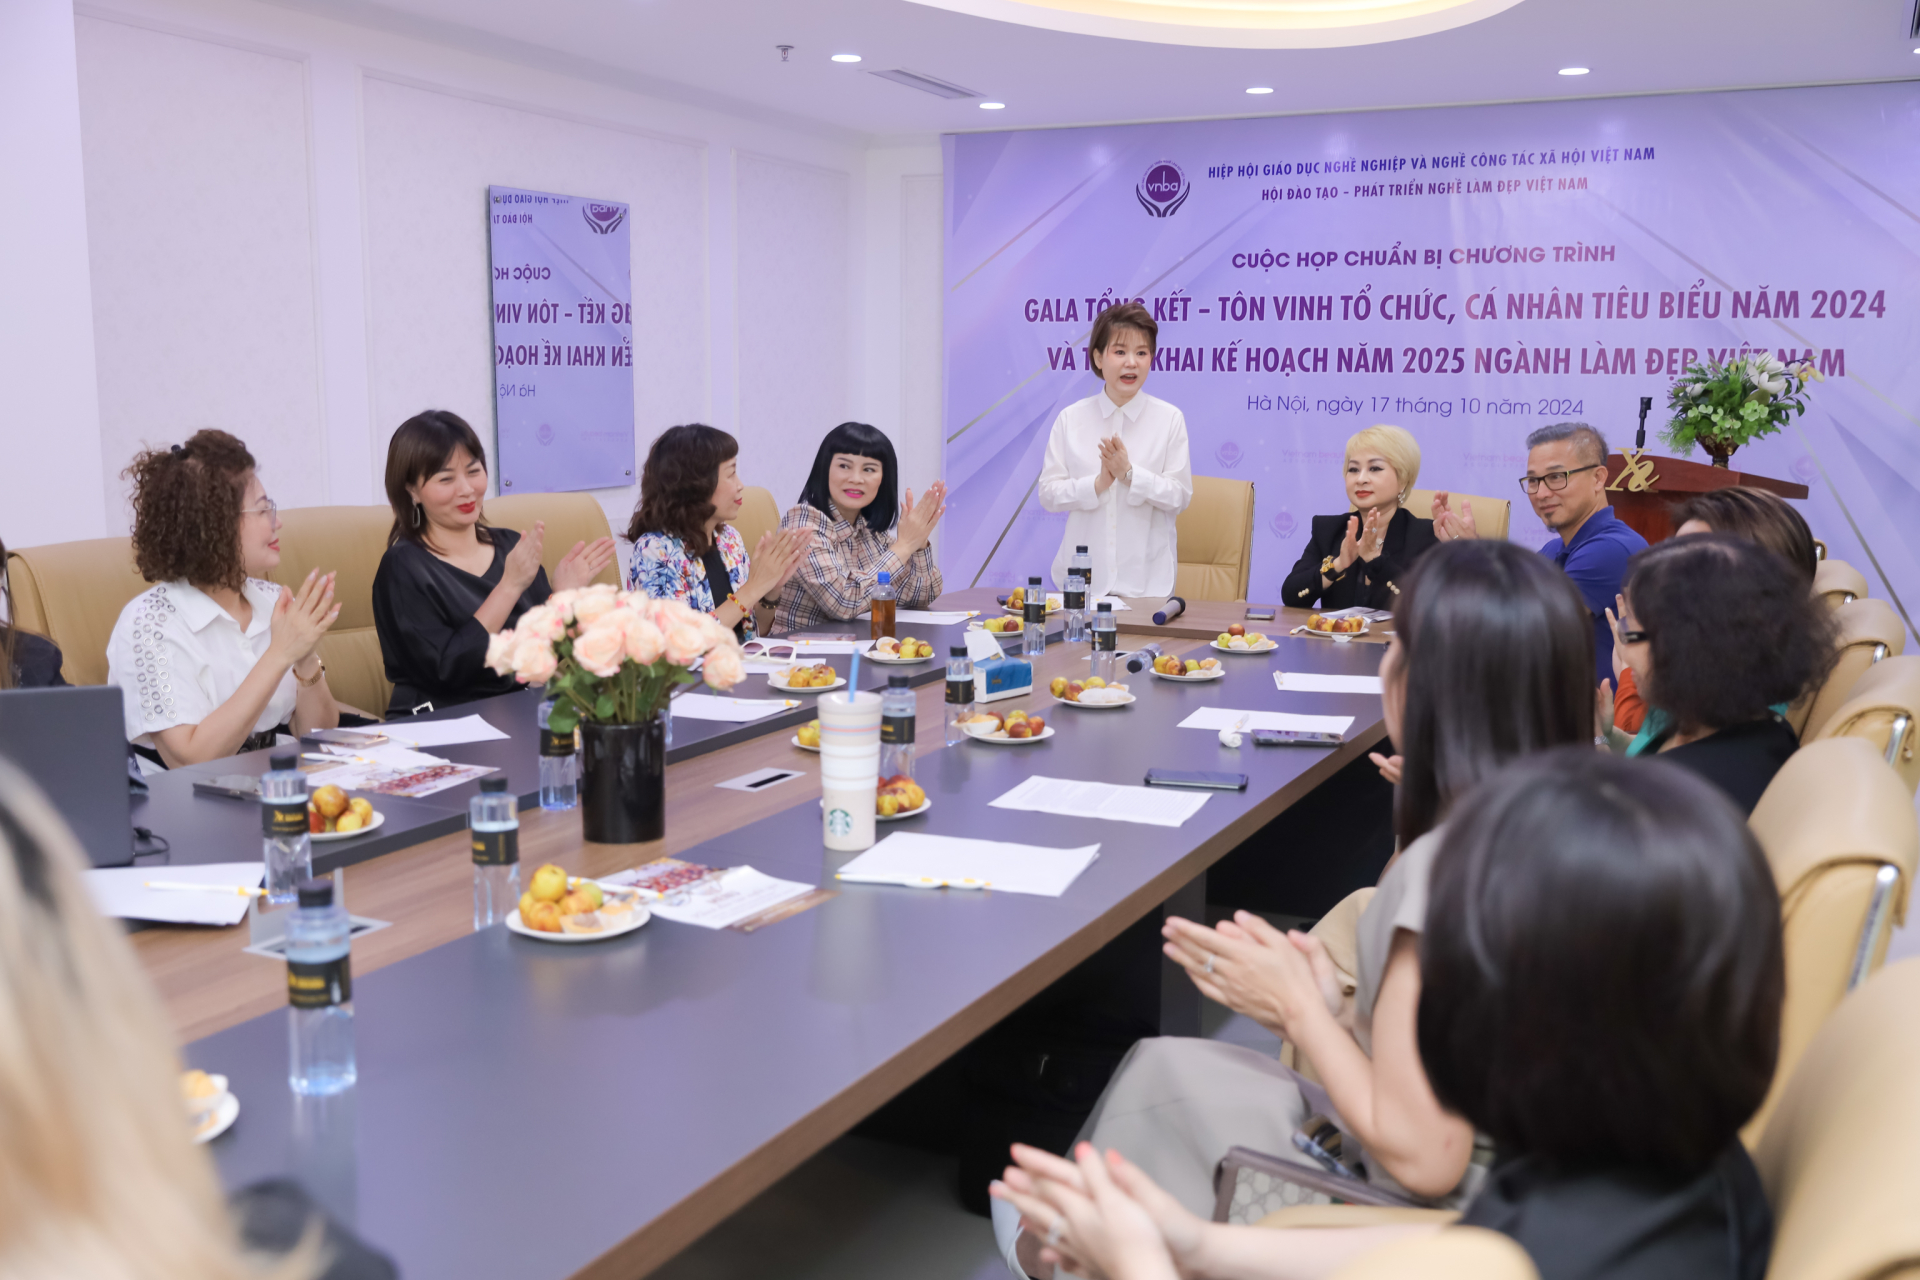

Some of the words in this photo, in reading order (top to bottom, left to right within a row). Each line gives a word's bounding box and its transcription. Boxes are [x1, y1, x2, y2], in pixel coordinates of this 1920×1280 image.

[1208, 163, 1234, 181] HIỆP
[1238, 162, 1259, 180] HỘI
[1263, 159, 1292, 176] GIÁO
[1296, 163, 1320, 178] DỤC
[1324, 153, 1356, 175] NGHỀ
[1361, 155, 1406, 173] NGHIỆP
[1411, 153, 1427, 170] VÀ
[1432, 150, 1466, 169] NGHỀ
[1470, 151, 1507, 168] CÔNG
[1512, 149, 1536, 166] TÁC
[1540, 148, 1556, 166] XÃ
[1561, 147, 1586, 166] HỘI
[1591, 146, 1619, 164] VIỆT
[1624, 147, 1655, 161] NAM
[1147, 170, 1179, 192] vnba
[1262, 188, 1283, 204] HỘI
[1287, 185, 1311, 201] ĐÀO
[1316, 187, 1339, 202] TẠO
[1354, 182, 1384, 198] PHÁT
[1389, 178, 1422, 196] TRIỂN
[1428, 178, 1462, 196] NGHỀ
[1466, 178, 1493, 194] LÀM
[1497, 178, 1521, 195] ĐẸP
[1526, 175, 1553, 194] VIỆT
[1558, 177, 1588, 191] NAM
[1232, 248, 1290, 273] CUỘC
[1297, 251, 1338, 272] HỌP
[1344, 241, 1417, 267] CHUẨN
[1423, 248, 1442, 270] BỊ
[1449, 245, 1546, 265] CHƯƠNG
[1553, 241, 1616, 263] TRÌNH
[1024, 298, 1079, 323] GALA
[1154, 288, 1192, 322] KẾT
[1218, 290, 1266, 322] TÔN
[1273, 295, 1333, 321] VINH
[1340, 283, 1372, 321] TỔ
[1379, 287, 1456, 325] CHỨC,
[1465, 286, 1498, 320] CÁ
[1506, 286, 1583, 320] NHÂN
[1592, 284, 1650, 319] TIÊU
[1659, 278, 1722, 319] BIỂU
[1731, 284, 1800, 319] NĂM
[1810, 289, 1886, 319] 2024
[1047, 340, 1077, 371] VÀ
[1150, 347, 1204, 372] KHAI
[1211, 338, 1244, 372] KẾ
[1245, 346, 1329, 378] HOẠCH
[1336, 341, 1394, 373] NĂM
[1402, 347, 1465, 374] 2025
[1474, 340, 1571, 375] NGÀNH
[1580, 340, 1636, 375] LÀM
[1645, 347, 1698, 381] ĐẸP
[1247, 395, 1272, 411] Hà
[1277, 394, 1310, 415] Nội,
[1316, 397, 1364, 416] ngày
[1370, 397, 1390, 413] 17
[1395, 396, 1452, 418] tháng
[1460, 397, 1481, 415] 10
[1486, 399, 1531, 415] năm
[1537, 399, 1584, 415] 2024
